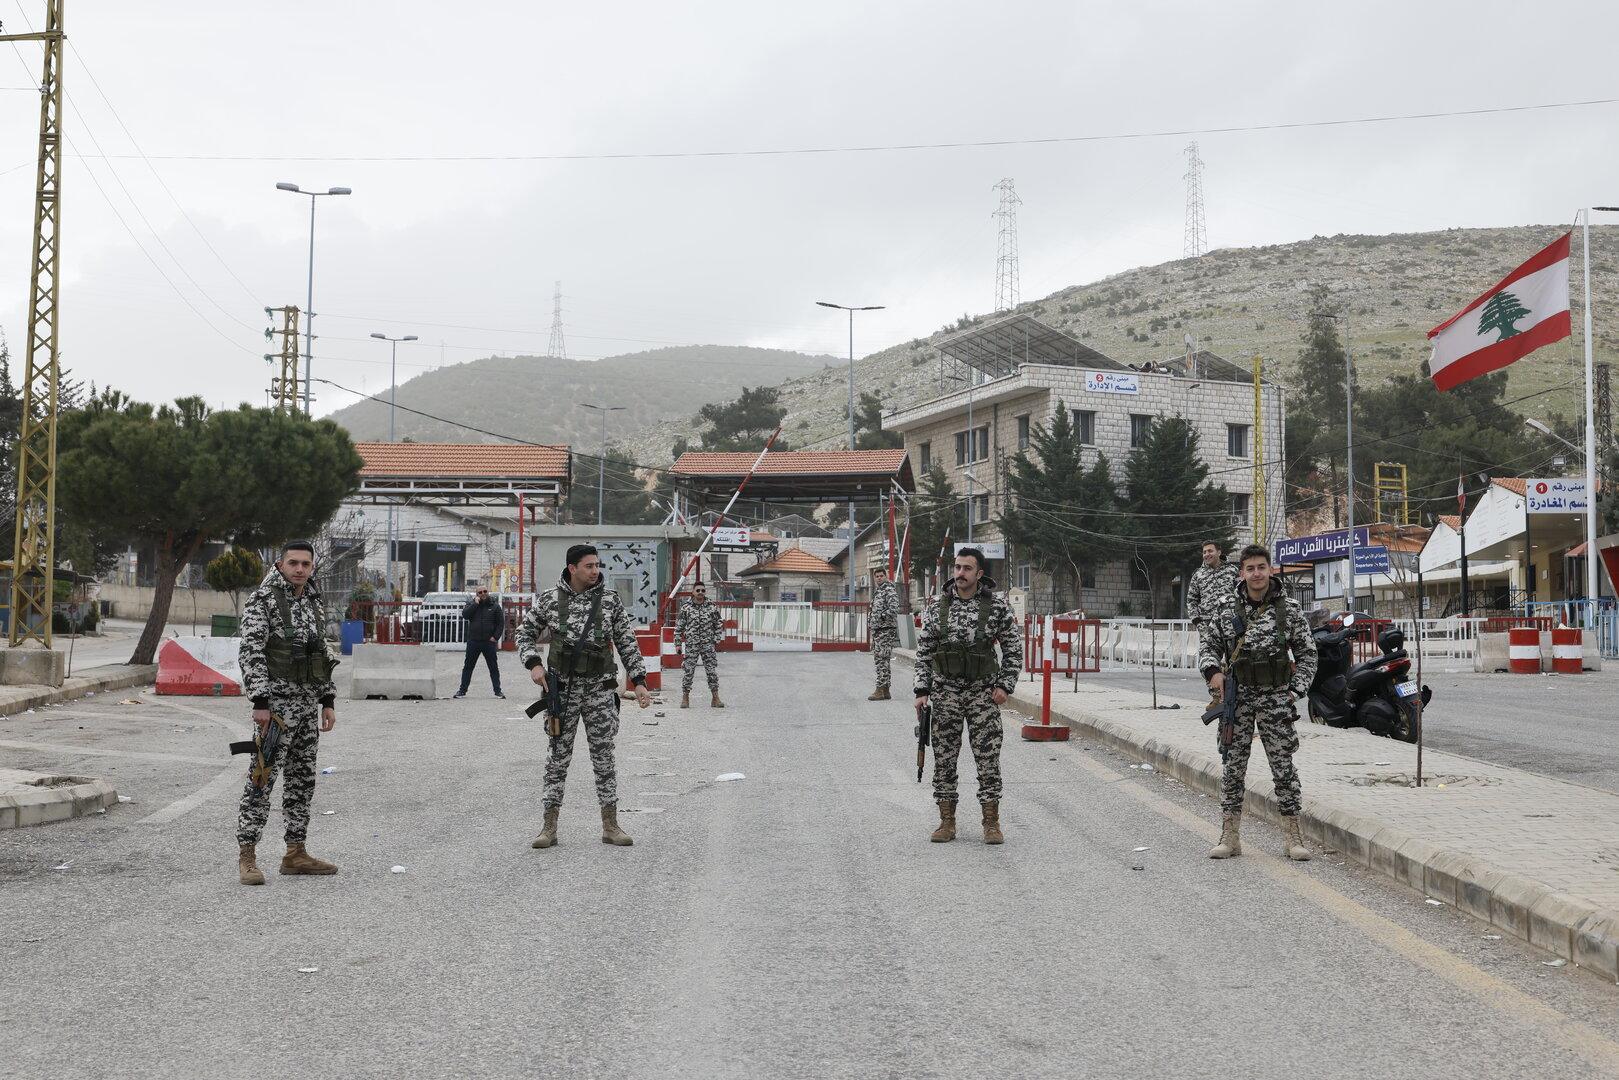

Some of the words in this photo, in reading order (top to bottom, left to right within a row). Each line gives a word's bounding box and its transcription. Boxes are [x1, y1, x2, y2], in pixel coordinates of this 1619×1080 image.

[1115, 383, 1137, 391] قسم
[1552, 482, 1566, 491] رقم
[1568, 483, 1585, 492] مبنى
[1530, 497, 1567, 511] المغادرة
[1569, 496, 1588, 511] سم
[1279, 542, 1300, 561] العام
[1301, 537, 1324, 557] الأمن
